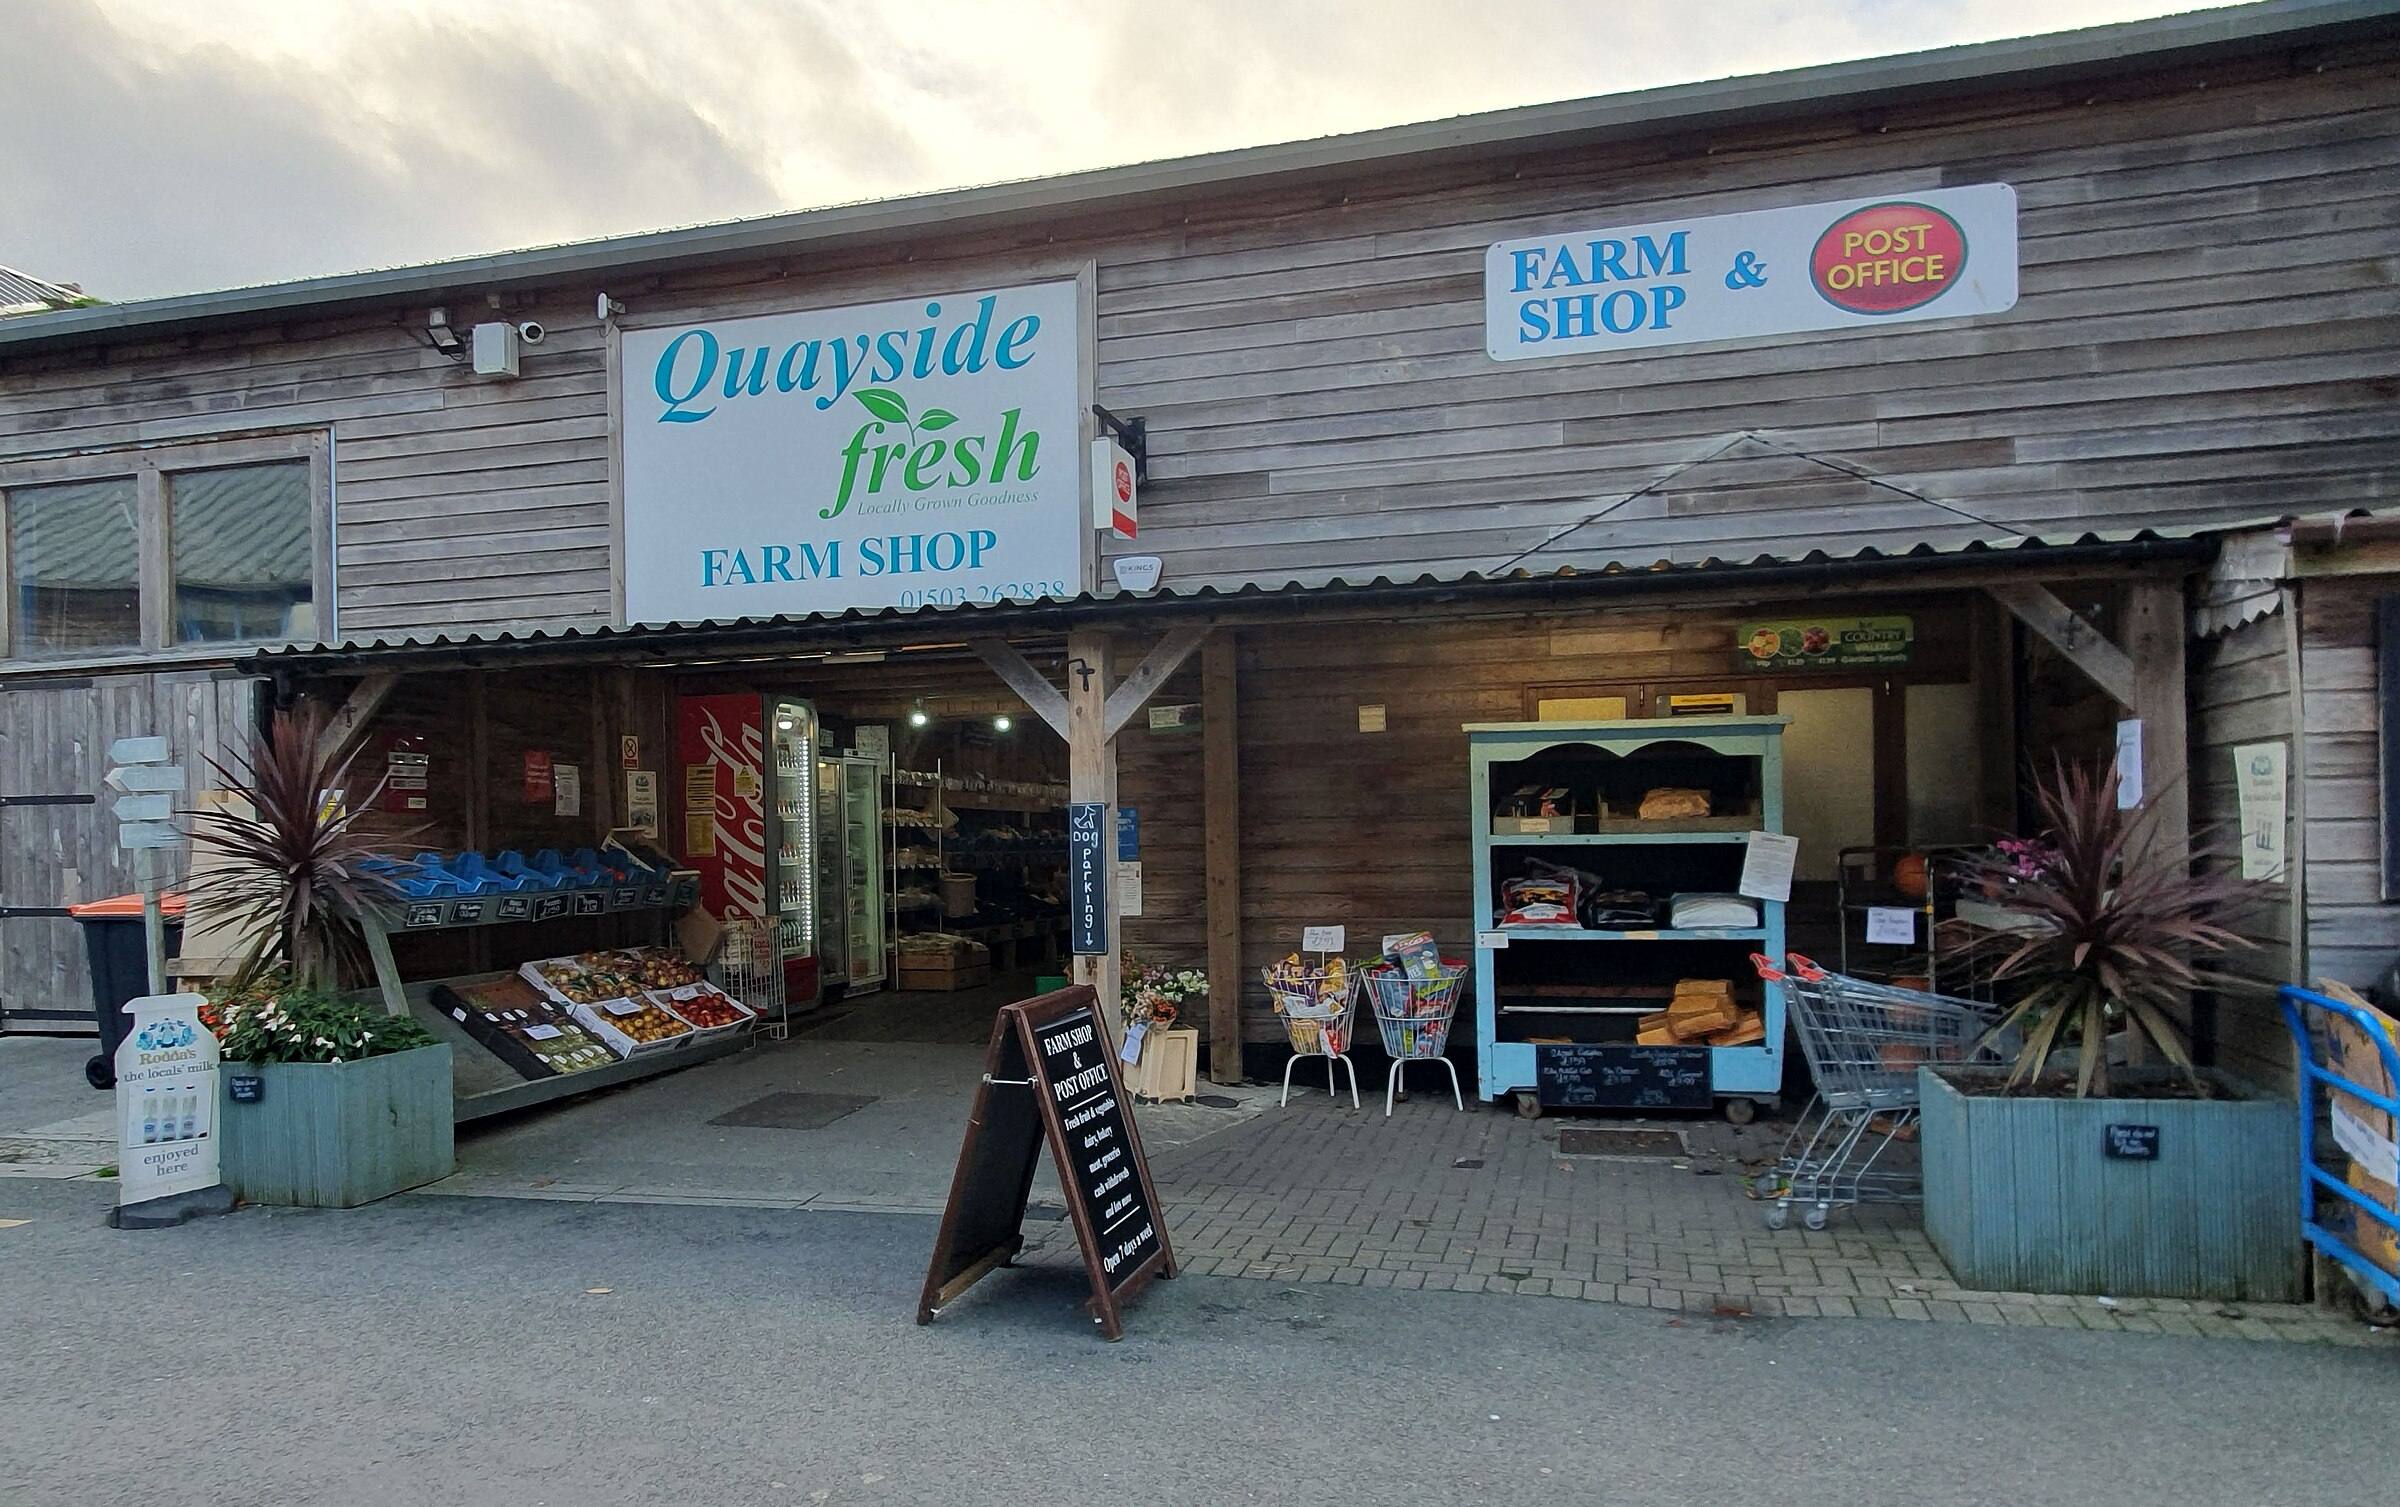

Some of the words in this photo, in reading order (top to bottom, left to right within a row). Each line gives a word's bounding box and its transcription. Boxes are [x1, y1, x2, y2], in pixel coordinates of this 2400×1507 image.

[1844, 222, 1932, 257] POST
[1510, 230, 1692, 294] FARM
[1725, 250, 1769, 290] &
[1826, 254, 1944, 291] OFFICE
[1519, 286, 1686, 343] SHOP
[655, 295, 1041, 423] Quayside
[819, 407, 1041, 519] fresh
[857, 498, 909, 516] Locally
[914, 496, 962, 512] Grown
[967, 490, 1039, 508] Goodness
[701, 539, 841, 587] FARM
[859, 530, 997, 577] SHOP
[901, 586, 967, 608] 01503
[1845, 630, 1900, 642] COUNTRY
[1043, 1031, 1073, 1056] FARM
[1070, 1024, 1094, 1047] SHOP
[124, 1071, 145, 1082] the
[187, 1060, 215, 1073] milk
[138, 1048, 197, 1066] Rodda's
[1072, 1051, 1083, 1069] &
[1053, 1075, 1079, 1102] POST
[1078, 1063, 1109, 1091] OFFICE
[143, 1144, 199, 1166] enjoyed
[156, 1162, 189, 1177] here
[1103, 1252, 1121, 1274] Open
[1118, 1244, 1125, 1260] 7
[1123, 1238, 1137, 1256] days
[1139, 1222, 1154, 1241] week
